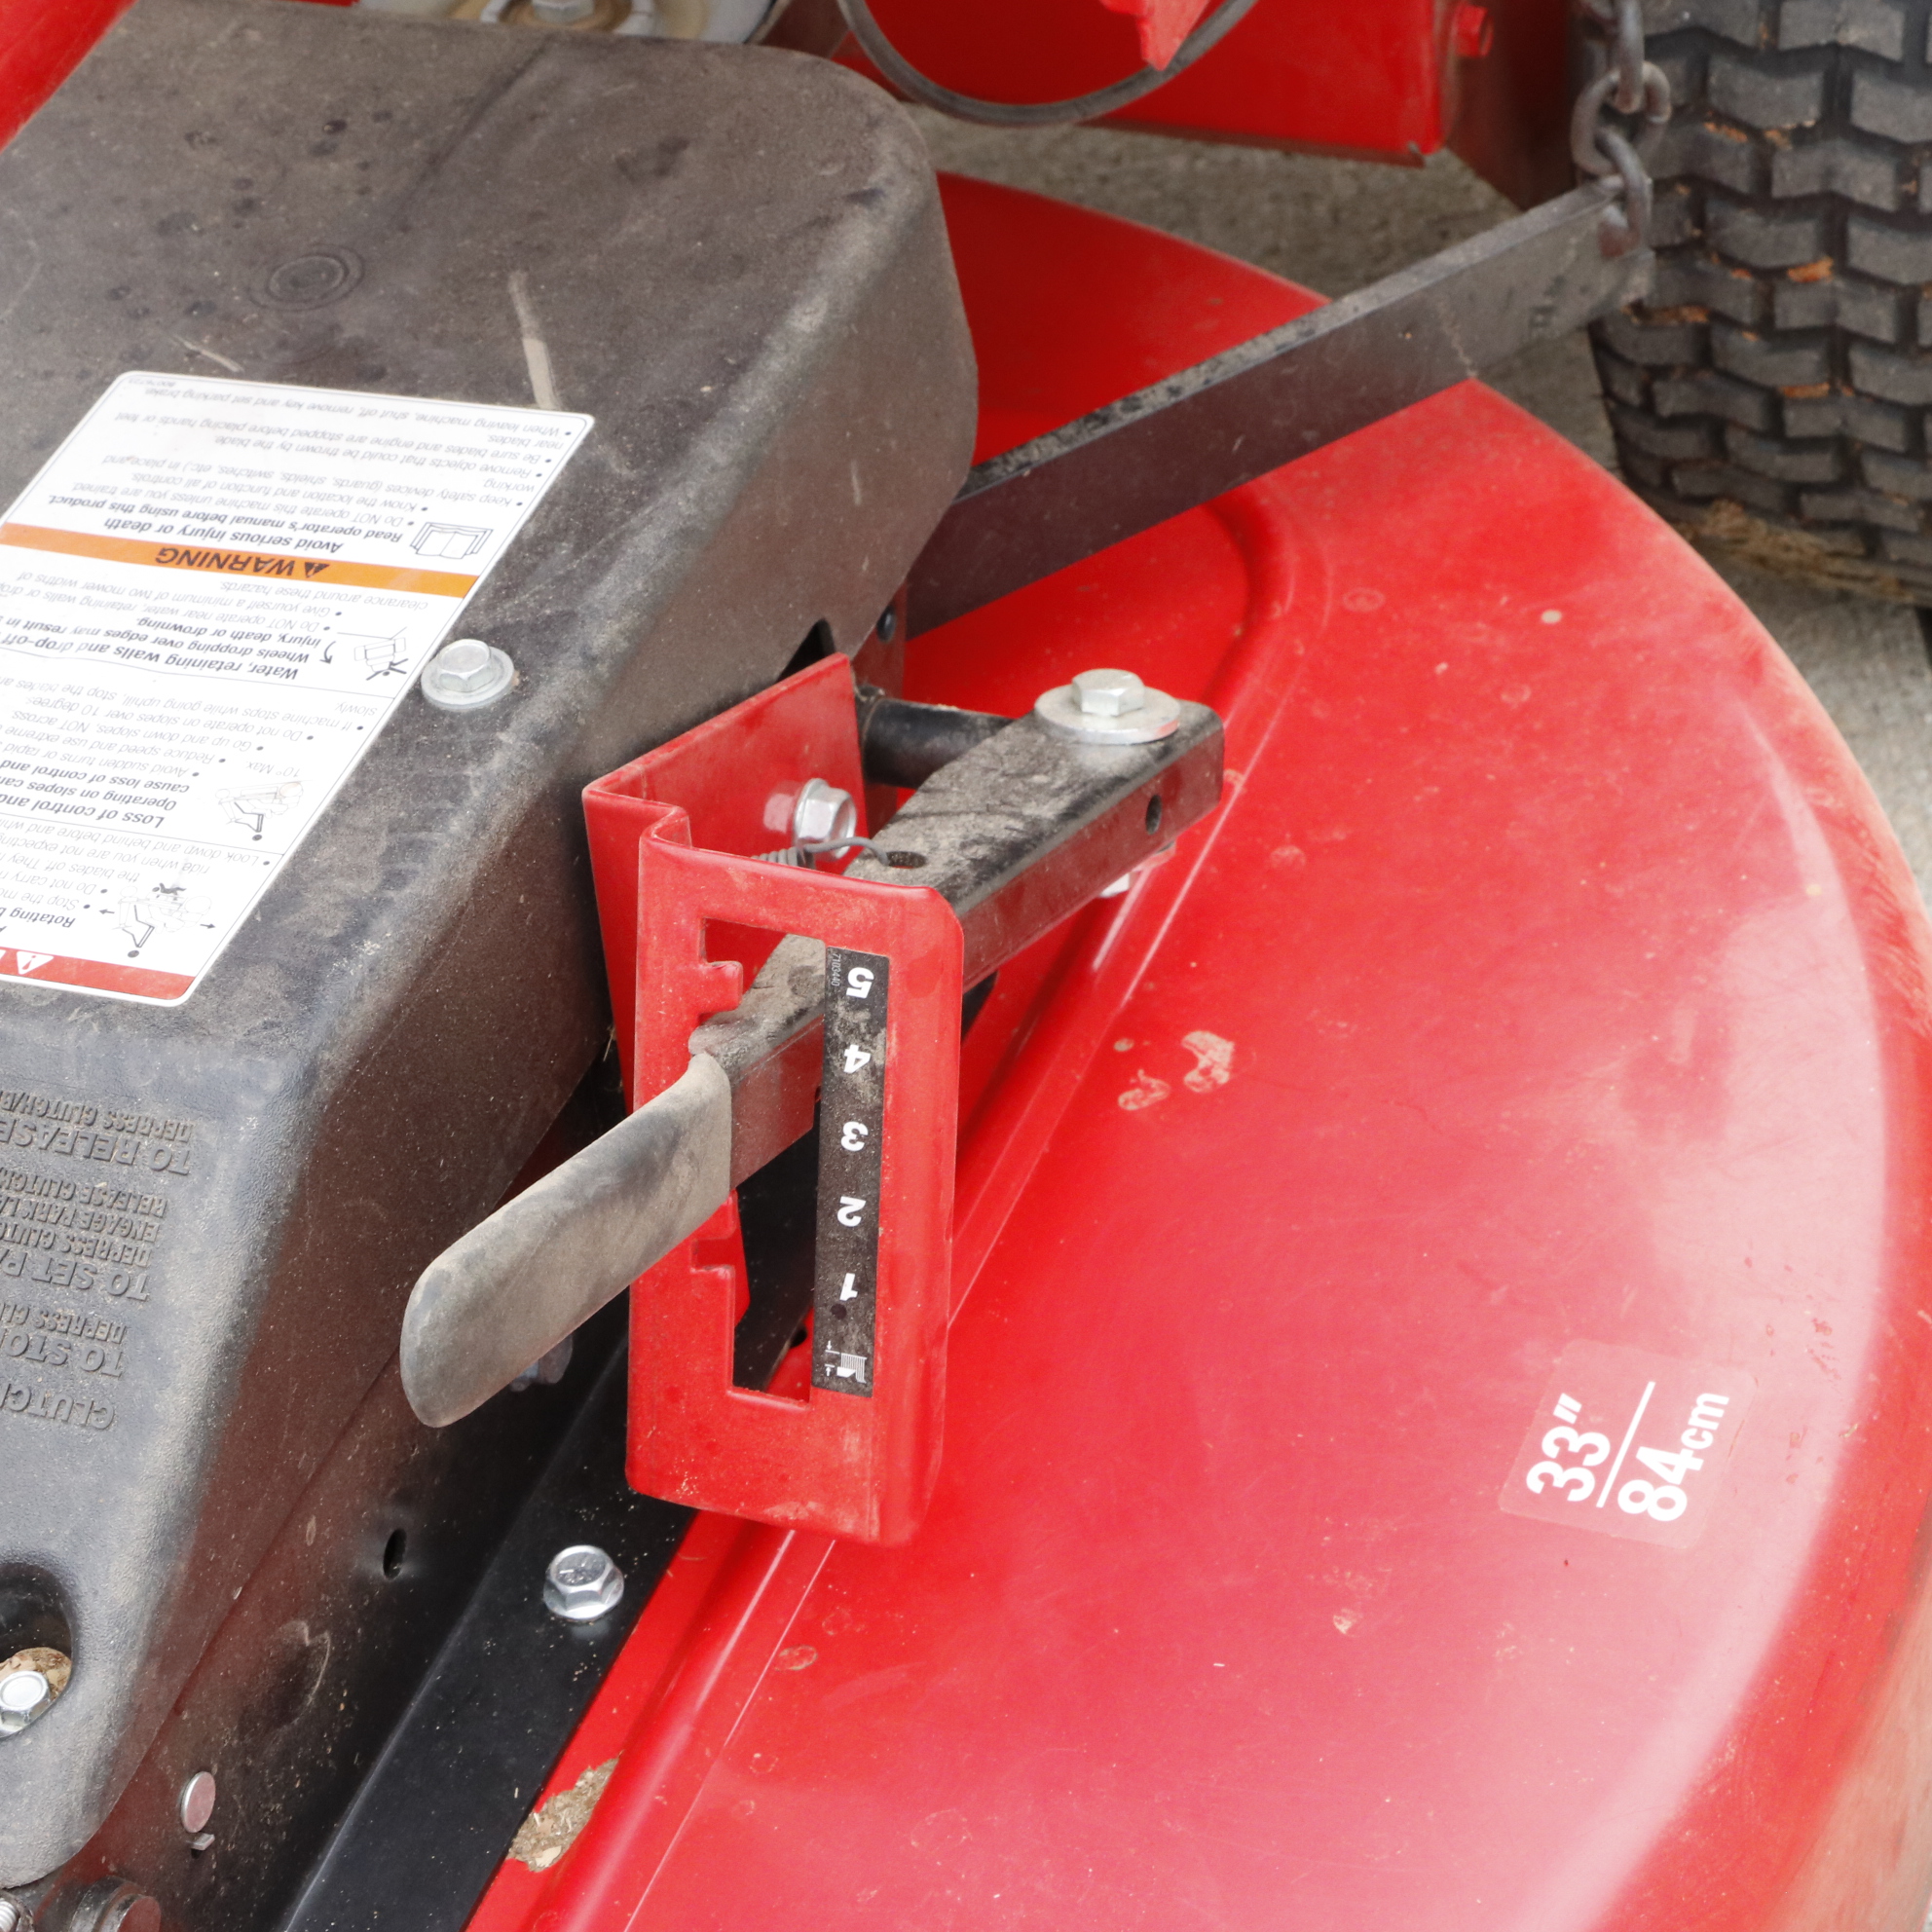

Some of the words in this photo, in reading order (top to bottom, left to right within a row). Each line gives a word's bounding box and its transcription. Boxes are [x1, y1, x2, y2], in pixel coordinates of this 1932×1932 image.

[212, 434, 251, 448] blade.
[252, 439, 275, 450] the
[277, 440, 294, 452] by
[295, 444, 340, 457] thrown
[342, 449, 360, 460] be
[359, 451, 399, 462] could
[399, 454, 427, 466] that
[428, 458, 477, 471] objects
[129, 471, 184, 485] controls.
[479, 464, 532, 479] Remove
[69, 482, 119, 496] trained.
[183, 478, 203, 489] all
[201, 480, 218, 490] of
[219, 482, 273, 497] function
[120, 487, 143, 497] are
[144, 490, 170, 500] you
[169, 493, 213, 504] unless
[272, 487, 301, 498] and
[302, 491, 354, 505] location
[49, 495, 107, 508] product.
[108, 502, 136, 514] this
[214, 497, 272, 511] machine
[355, 497, 378, 507] the
[380, 500, 418, 512] Know
[138, 503, 179, 517] using
[273, 503, 298, 515] this
[300, 506, 351, 519] operate
[181, 510, 229, 524] before
[229, 515, 285, 528] manual
[351, 512, 382, 525] NOT
[384, 516, 404, 528] Do
[103, 518, 153, 534] death
[155, 524, 174, 534] or
[177, 524, 227, 541] injury
[288, 521, 362, 536] operator's
[230, 532, 293, 546] serious
[363, 530, 403, 542] Read
[294, 539, 344, 553] Avoid
[155, 547, 295, 576] WARNING
[16, 572, 33, 581] of
[34, 574, 79, 588] widths
[80, 581, 127, 595] mower
[129, 588, 153, 600] two
[218, 580, 273, 596] hazards.
[275, 586, 312, 599] these
[42, 591, 77, 604] walls
[153, 591, 170, 602] of
[171, 593, 234, 607] minimum
[312, 590, 362, 603] around
[79, 595, 138, 612] retaining
[142, 604, 179, 615] water,
[236, 599, 246, 608] a
[245, 601, 301, 612] yourself
[363, 595, 428, 612] clearance
[182, 610, 213, 620] near
[302, 606, 331, 617] Give
[6, 617, 21, 628] in
[215, 613, 266, 625] operate
[266, 618, 298, 630] NOT
[22, 620, 68, 634] result
[70, 625, 101, 636] may
[136, 616, 208, 637] drowning.
[300, 621, 320, 633] Do
[103, 629, 149, 642] edges
[230, 630, 273, 643] death
[278, 633, 321, 649] injury,
[1, 633, 74, 653] drop-off
[75, 643, 111, 653] and
[150, 637, 184, 649] over
[187, 640, 253, 656] dropping
[113, 647, 161, 662] walls
[256, 649, 310, 663] Wheels
[165, 653, 243, 672] retaining
[247, 662, 299, 680] Water,
[81, 704, 100, 717] 10
[104, 710, 134, 721] over
[10, 710, 58, 725] across.
[136, 713, 181, 725] slopes
[182, 718, 202, 726] on
[57, 720, 91, 733] NOT
[96, 724, 141, 738] slopes,
[203, 720, 255, 732] operate
[256, 725, 280, 736] not
[4, 726, 60, 743] extreme
[142, 730, 180, 742] down
[180, 734, 210, 744] and
[211, 736, 231, 746] up
[282, 729, 304, 742] Do
[62, 736, 89, 747] use
[88, 740, 118, 751] and
[232, 740, 252, 752] Go
[2, 743, 41, 757] rapid
[41, 750, 58, 760] or
[117, 744, 162, 756] speed
[163, 749, 215, 764] Reduce
[1, 760, 31, 771] and
[59, 753, 96, 766] turns
[98, 759, 150, 771] sudden
[31, 765, 88, 780] control
[149, 763, 189, 778] Avoid
[87, 774, 107, 784] of
[109, 776, 141, 789] loss
[26, 781, 78, 797] slopes
[143, 780, 190, 793] cause
[80, 789, 100, 799] on
[102, 790, 177, 811] Operating
[30, 799, 96, 816] control
[95, 809, 119, 821] of
[122, 812, 165, 829] Loss
[59, 844, 85, 856] not
[86, 848, 111, 860] are
[7, 852, 40, 870] They
[112, 852, 141, 863] you
[140, 857, 179, 870] when
[41, 860, 66, 872] off.
[68, 864, 115, 879] blades
[179, 862, 210, 874] ride
[117, 871, 140, 883] the
[10, 907, 76, 928] Rotating
[845, 967, 874, 998] 5
[843, 1044, 871, 1073] 4
[102, 1111, 193, 1143] DEPRESS
[840, 1120, 869, 1152] 3
[149, 1146, 190, 1176] TO
[79, 1186, 167, 1219] RELEASE
[21, 1200, 76, 1228] PARK
[836, 1196, 867, 1227] 2
[79, 1210, 160, 1244] ENGAGE
[60, 1236, 152, 1268] DEPRESS
[31, 1258, 98, 1291] SET
[107, 1270, 149, 1303] TO
[839, 1273, 858, 1301] 1
[35, 1310, 127, 1345] DEPRESS
[0, 1329, 72, 1366] STO
[80, 1347, 123, 1379] TO
